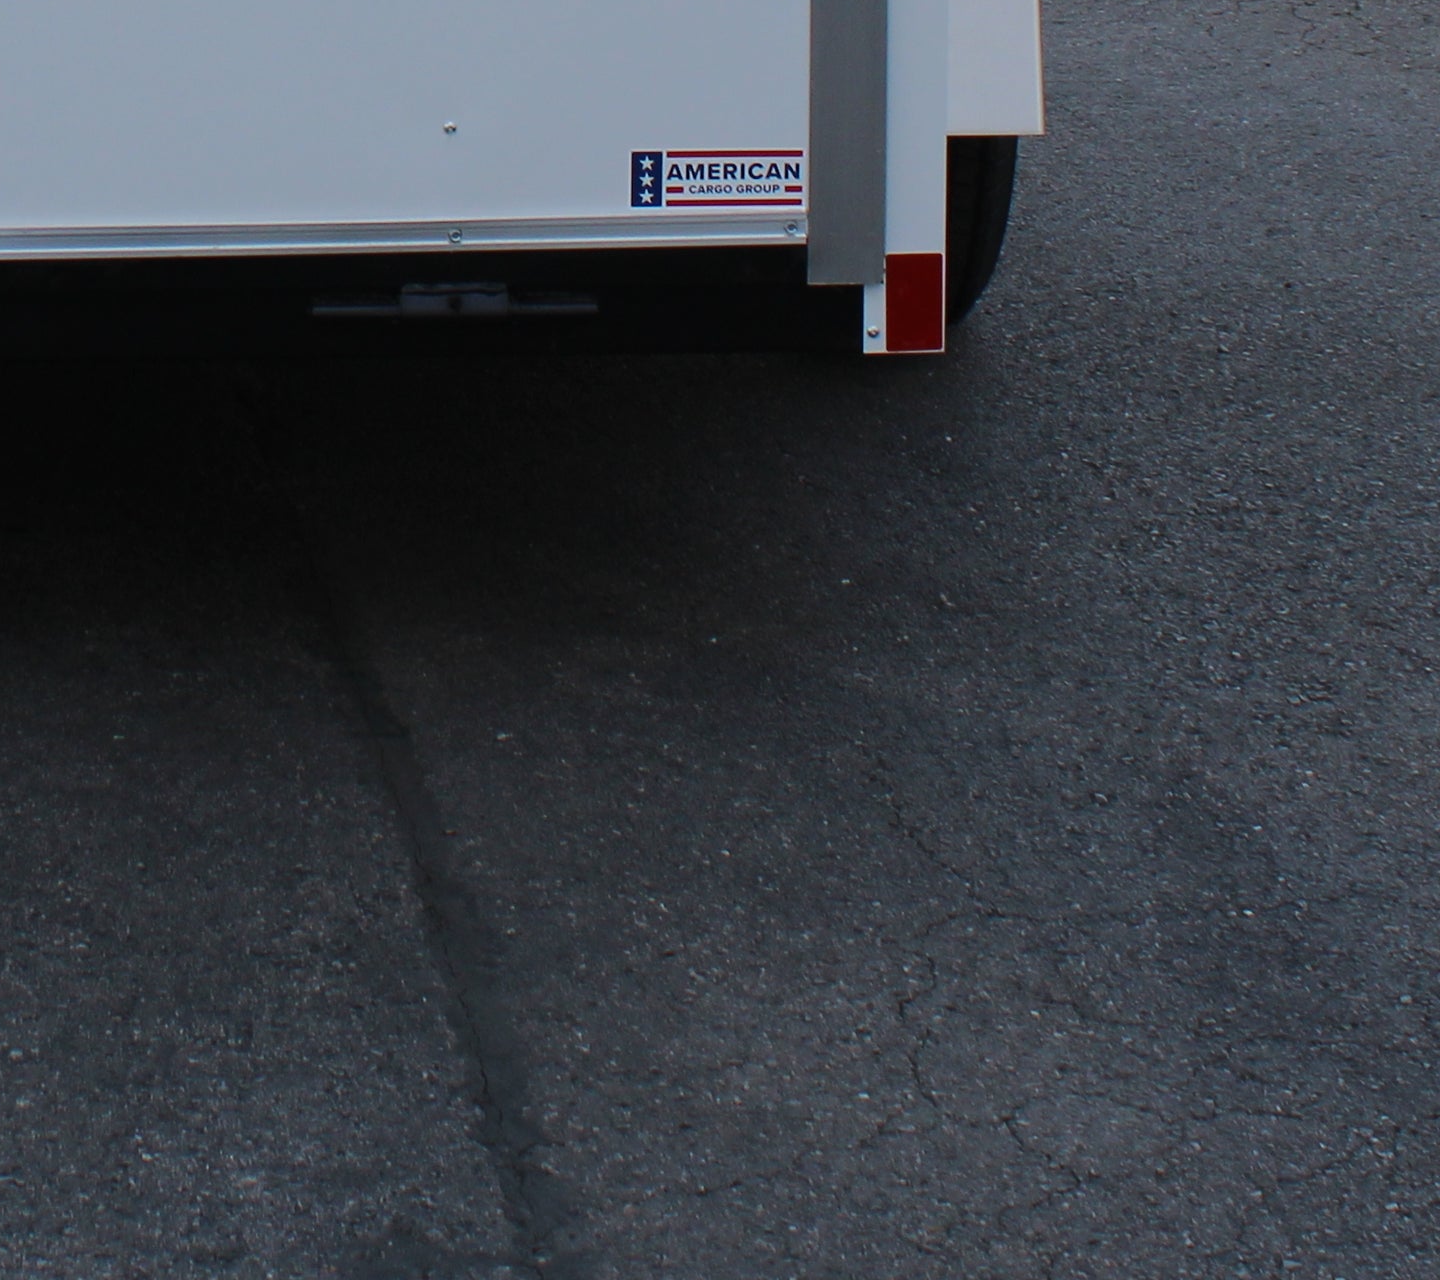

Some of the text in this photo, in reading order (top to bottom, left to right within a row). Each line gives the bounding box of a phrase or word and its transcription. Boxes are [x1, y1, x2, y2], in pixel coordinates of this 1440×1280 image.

[666, 162, 801, 181] AMERICAN
[688, 184, 781, 194] CARGO GROUP
